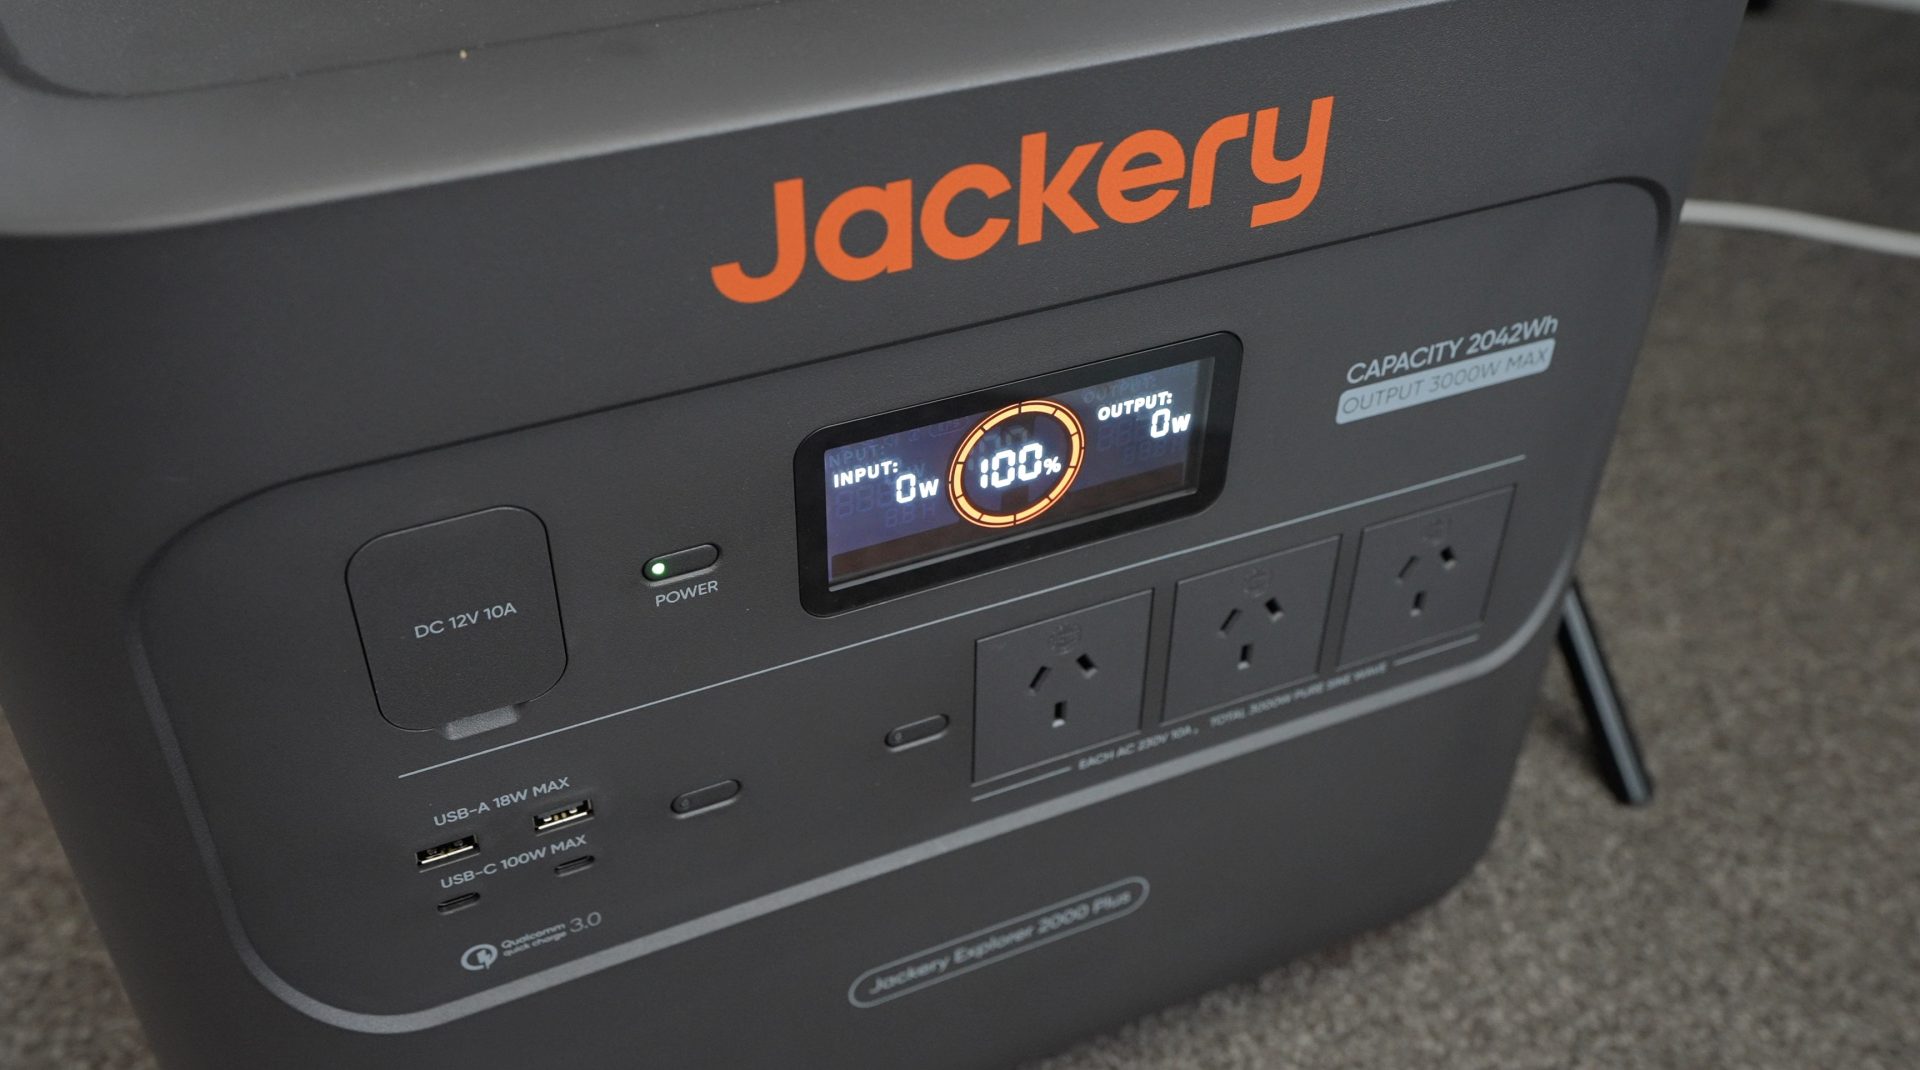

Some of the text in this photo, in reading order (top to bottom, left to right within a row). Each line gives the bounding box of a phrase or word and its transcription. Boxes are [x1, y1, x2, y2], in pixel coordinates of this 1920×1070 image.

[710, 96, 1334, 303] Jackery
[1347, 315, 1558, 384] CAPACITY 2042Wh
[1097, 391, 1173, 421] OUTPUT:
[1342, 347, 1548, 415] OUTPUT 3000W MAX
[833, 460, 899, 488] INPUT:
[655, 580, 719, 607] POWER
[414, 602, 517, 639] DC 12V 10A
[1078, 750, 1115, 770] EACH
[1115, 743, 1136, 757] AC
[1209, 707, 1247, 728] TOTAL
[1294, 681, 1325, 700] PURE
[433, 777, 570, 827] USB-A 18W MAX
[440, 835, 587, 889] USB-C 100W MAX
[501, 923, 566, 949] Qualcomm
[569, 911, 602, 933] 3.0
[869, 891, 1131, 994] Jackery Explorer 2000 Plus
